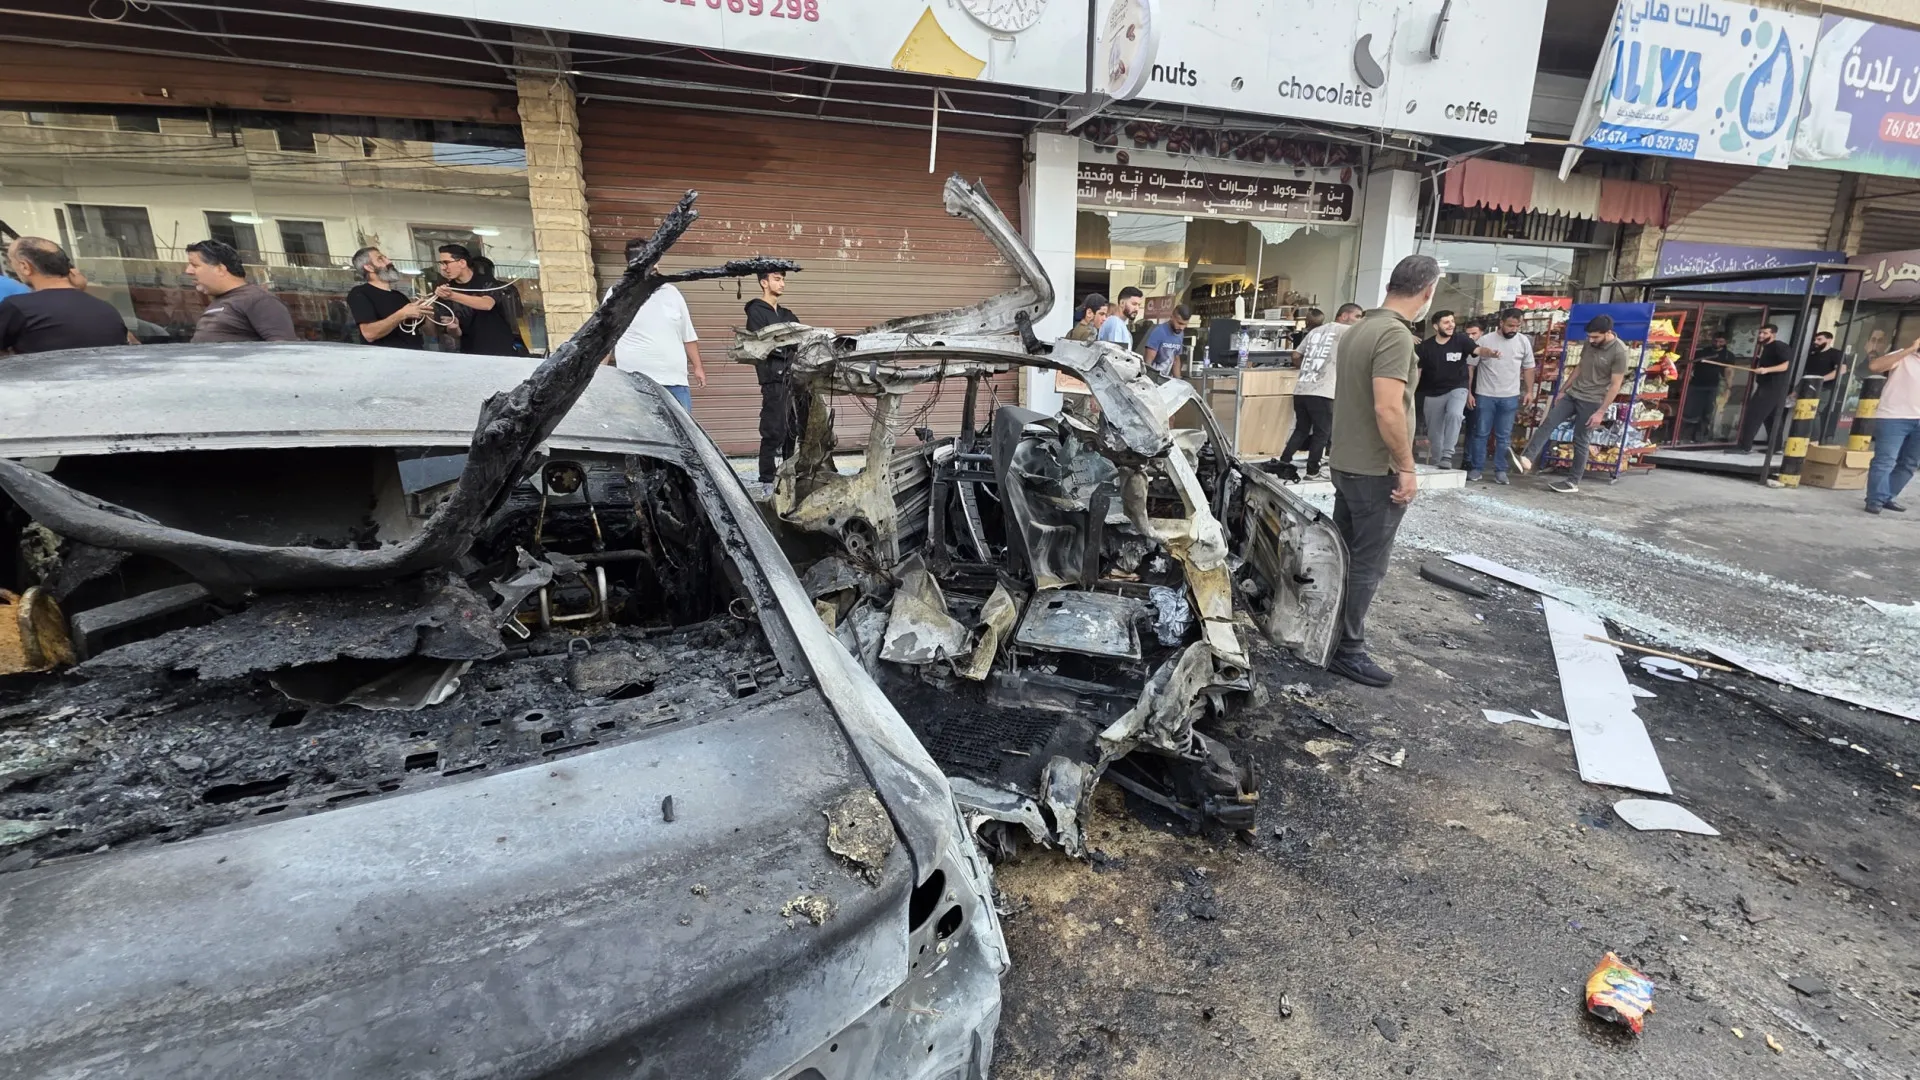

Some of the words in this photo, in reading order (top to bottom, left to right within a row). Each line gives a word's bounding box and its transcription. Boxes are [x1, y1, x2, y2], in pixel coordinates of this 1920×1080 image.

[770, 0, 820, 22] 298
[1675, 3, 1731, 37] محلات
[1151, 61, 1198, 87] nuts
[1844, 45, 1901, 103] بلدية
[1278, 75, 1373, 108] chocolate
[1444, 101, 1498, 125] coffee
[1905, 120, 1920, 139] 82
[1655, 135, 1675, 149] 527
[1675, 136, 1695, 152] 385
[1259, 200, 1288, 212] عسل
